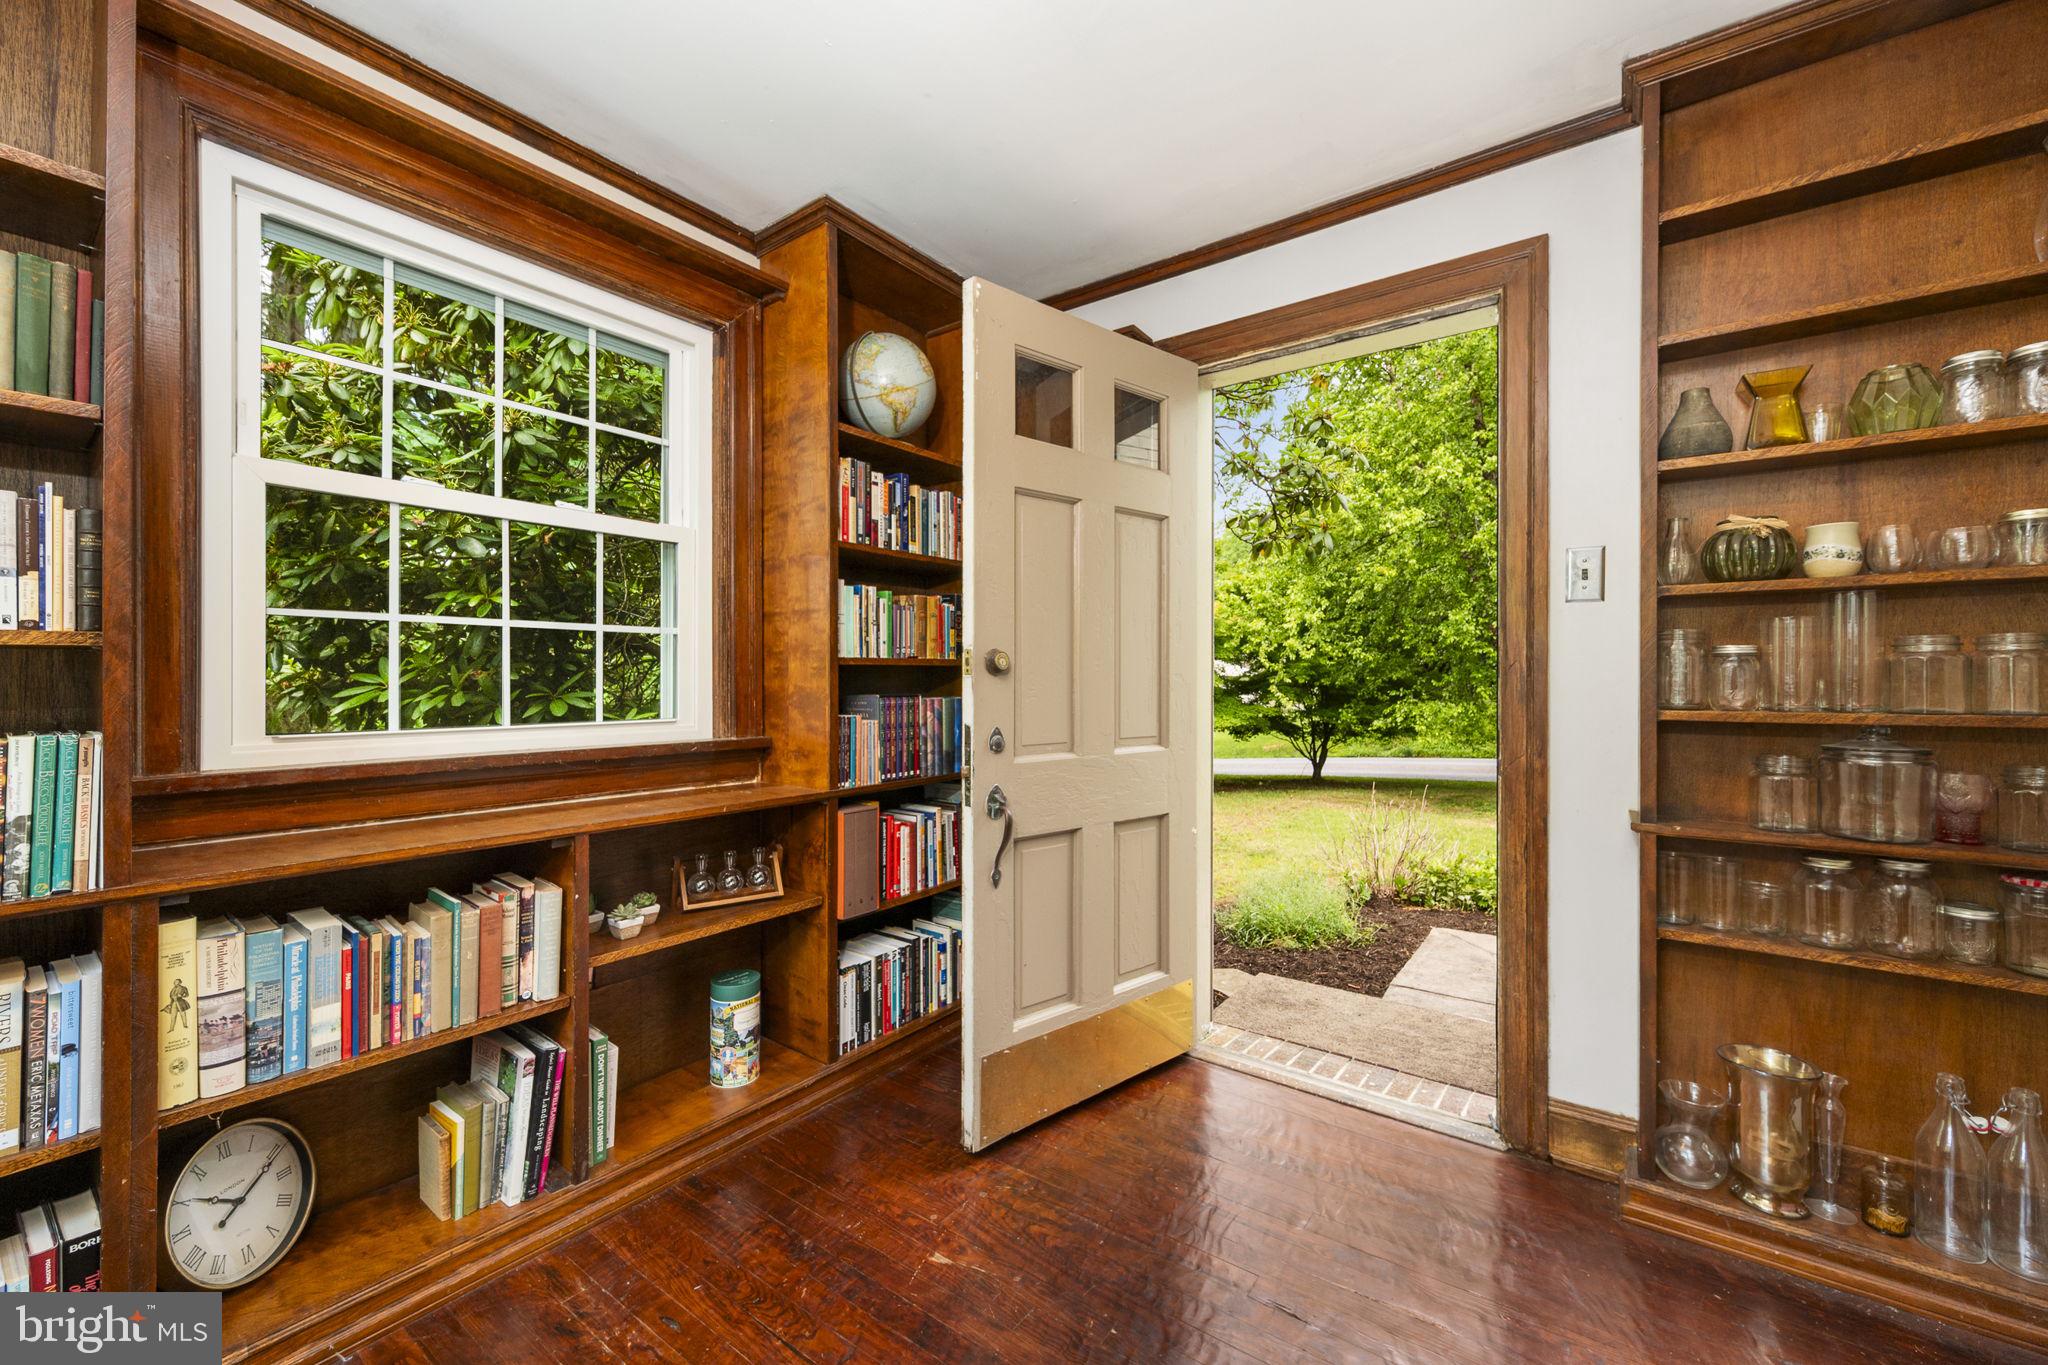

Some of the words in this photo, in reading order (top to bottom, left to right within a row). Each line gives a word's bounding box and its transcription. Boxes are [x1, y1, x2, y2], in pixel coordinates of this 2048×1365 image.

[40, 770, 55, 798] BASICS
[63, 769, 77, 796] BASICS
[81, 777, 90, 797] BACK
[39, 802, 50, 830] YOUNG
[62, 801, 73, 828] YOUNG
[80, 804, 89, 829] BASICS
[38, 831, 49, 846] LIFE
[61, 829, 72, 844] LIFE
[214, 939, 229, 991] Philadelphia
[30, 993, 47, 1004] 7
[67, 990, 77, 1029] bittersweet
[729, 999, 753, 1012] NATIONAL
[30, 1004, 46, 1058] WOMEN
[30, 1060, 43, 1084] ERIC
[597, 1053, 605, 1076] DON'T
[554, 1079, 562, 1091] THE
[597, 1076, 605, 1100] THINK
[29, 1085, 42, 1129] METAXAS
[597, 1100, 605, 1125] ABOUT
[533, 1097, 550, 1152] Landscaping
[216, 1140, 232, 1162] XII
[596, 1125, 604, 1152] DINNER
[219, 1178, 246, 1195] LONDON
